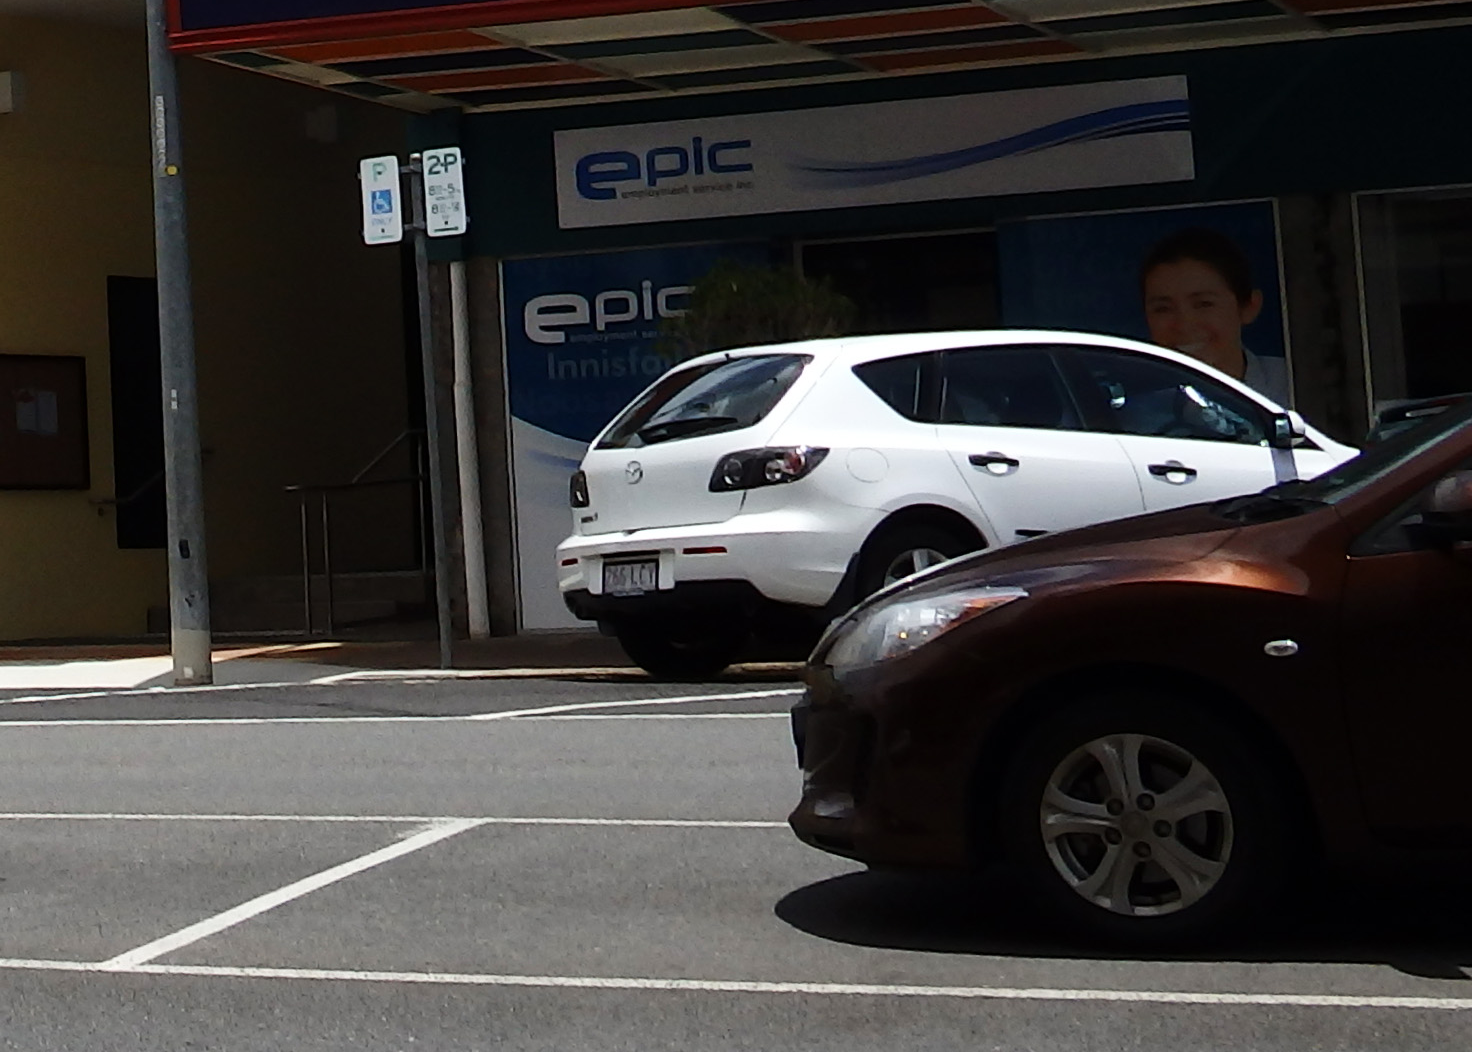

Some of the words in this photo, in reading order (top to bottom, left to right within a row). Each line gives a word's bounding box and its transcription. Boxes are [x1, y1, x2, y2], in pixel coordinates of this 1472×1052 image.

[427, 153, 458, 175] 2P
[575, 136, 753, 200] epic
[547, 347, 678, 380] Innisfa
